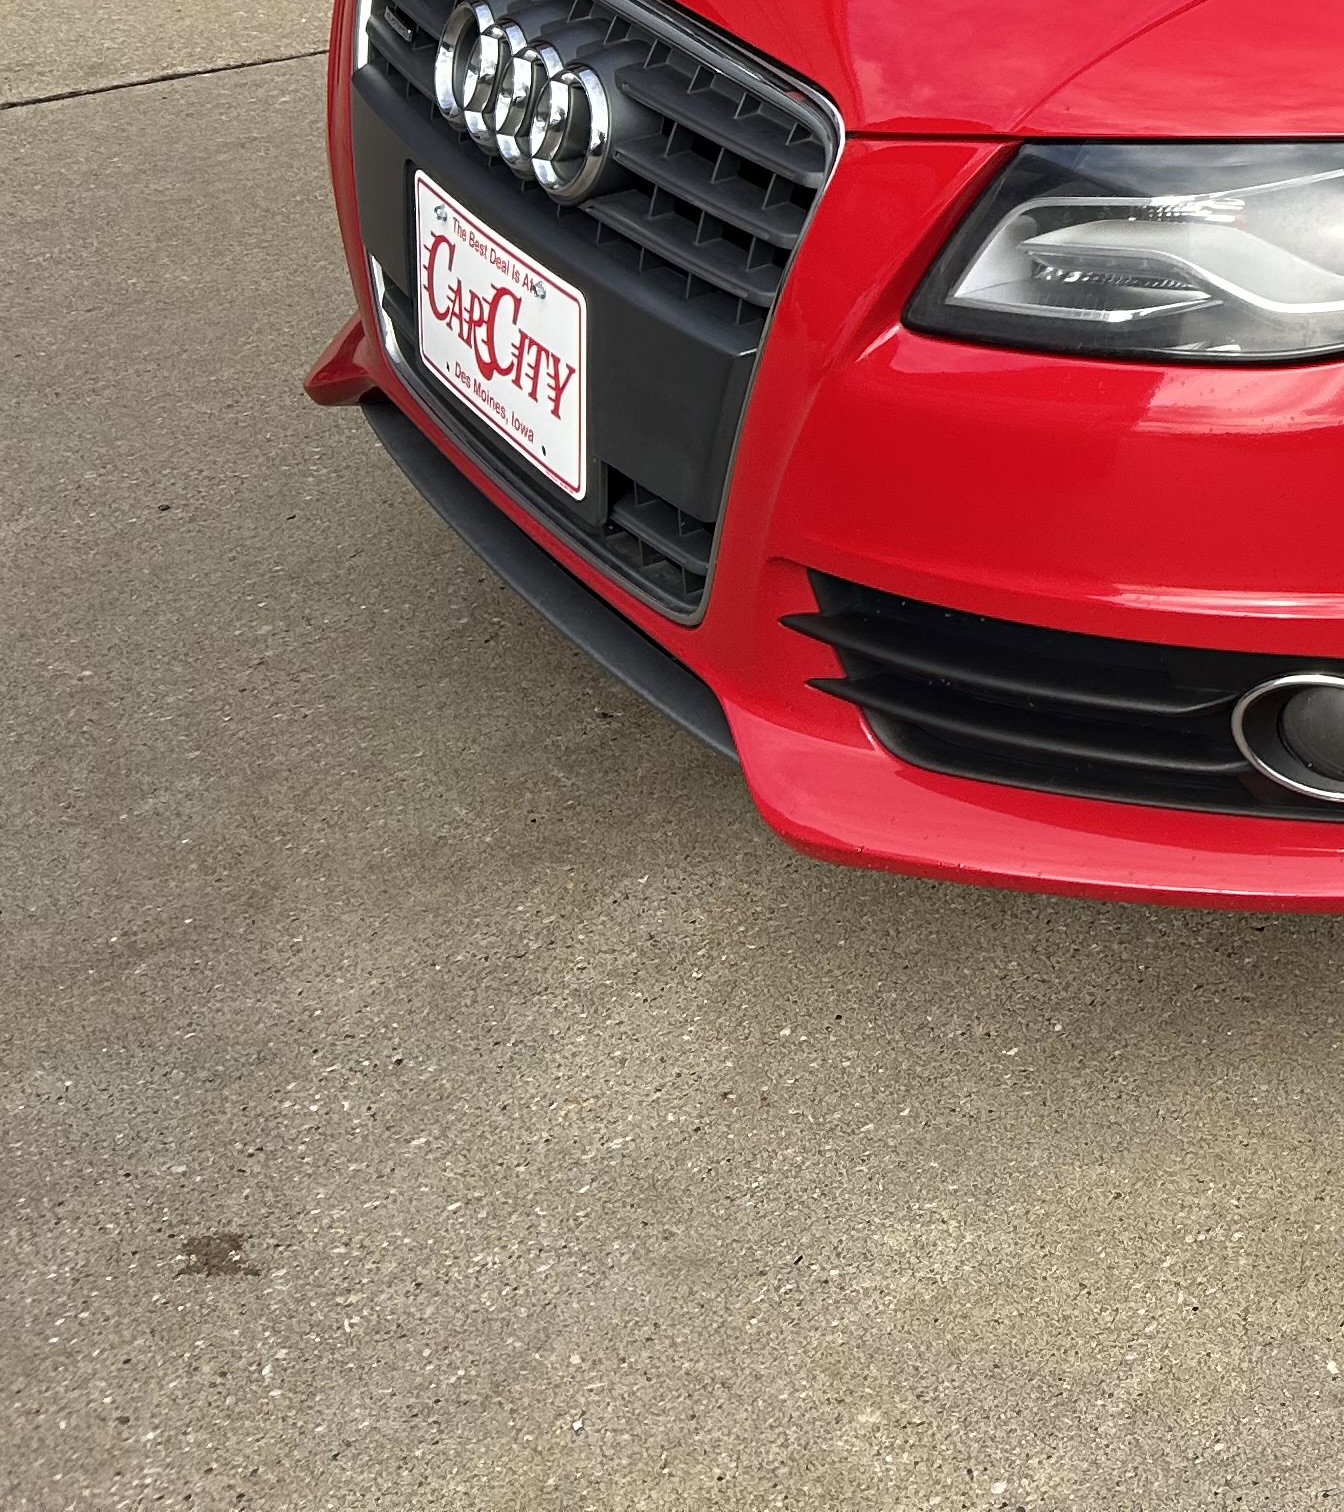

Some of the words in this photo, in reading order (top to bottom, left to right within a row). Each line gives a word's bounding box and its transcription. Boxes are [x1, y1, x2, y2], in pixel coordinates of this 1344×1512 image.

[452, 216, 467, 241] The
[469, 230, 488, 260] Best
[490, 246, 510, 276] Deal
[512, 264, 521, 284] Is
[454, 361, 471, 389] Des
[473, 379, 510, 425] Moines,
[511, 411, 535, 444] Iowa
